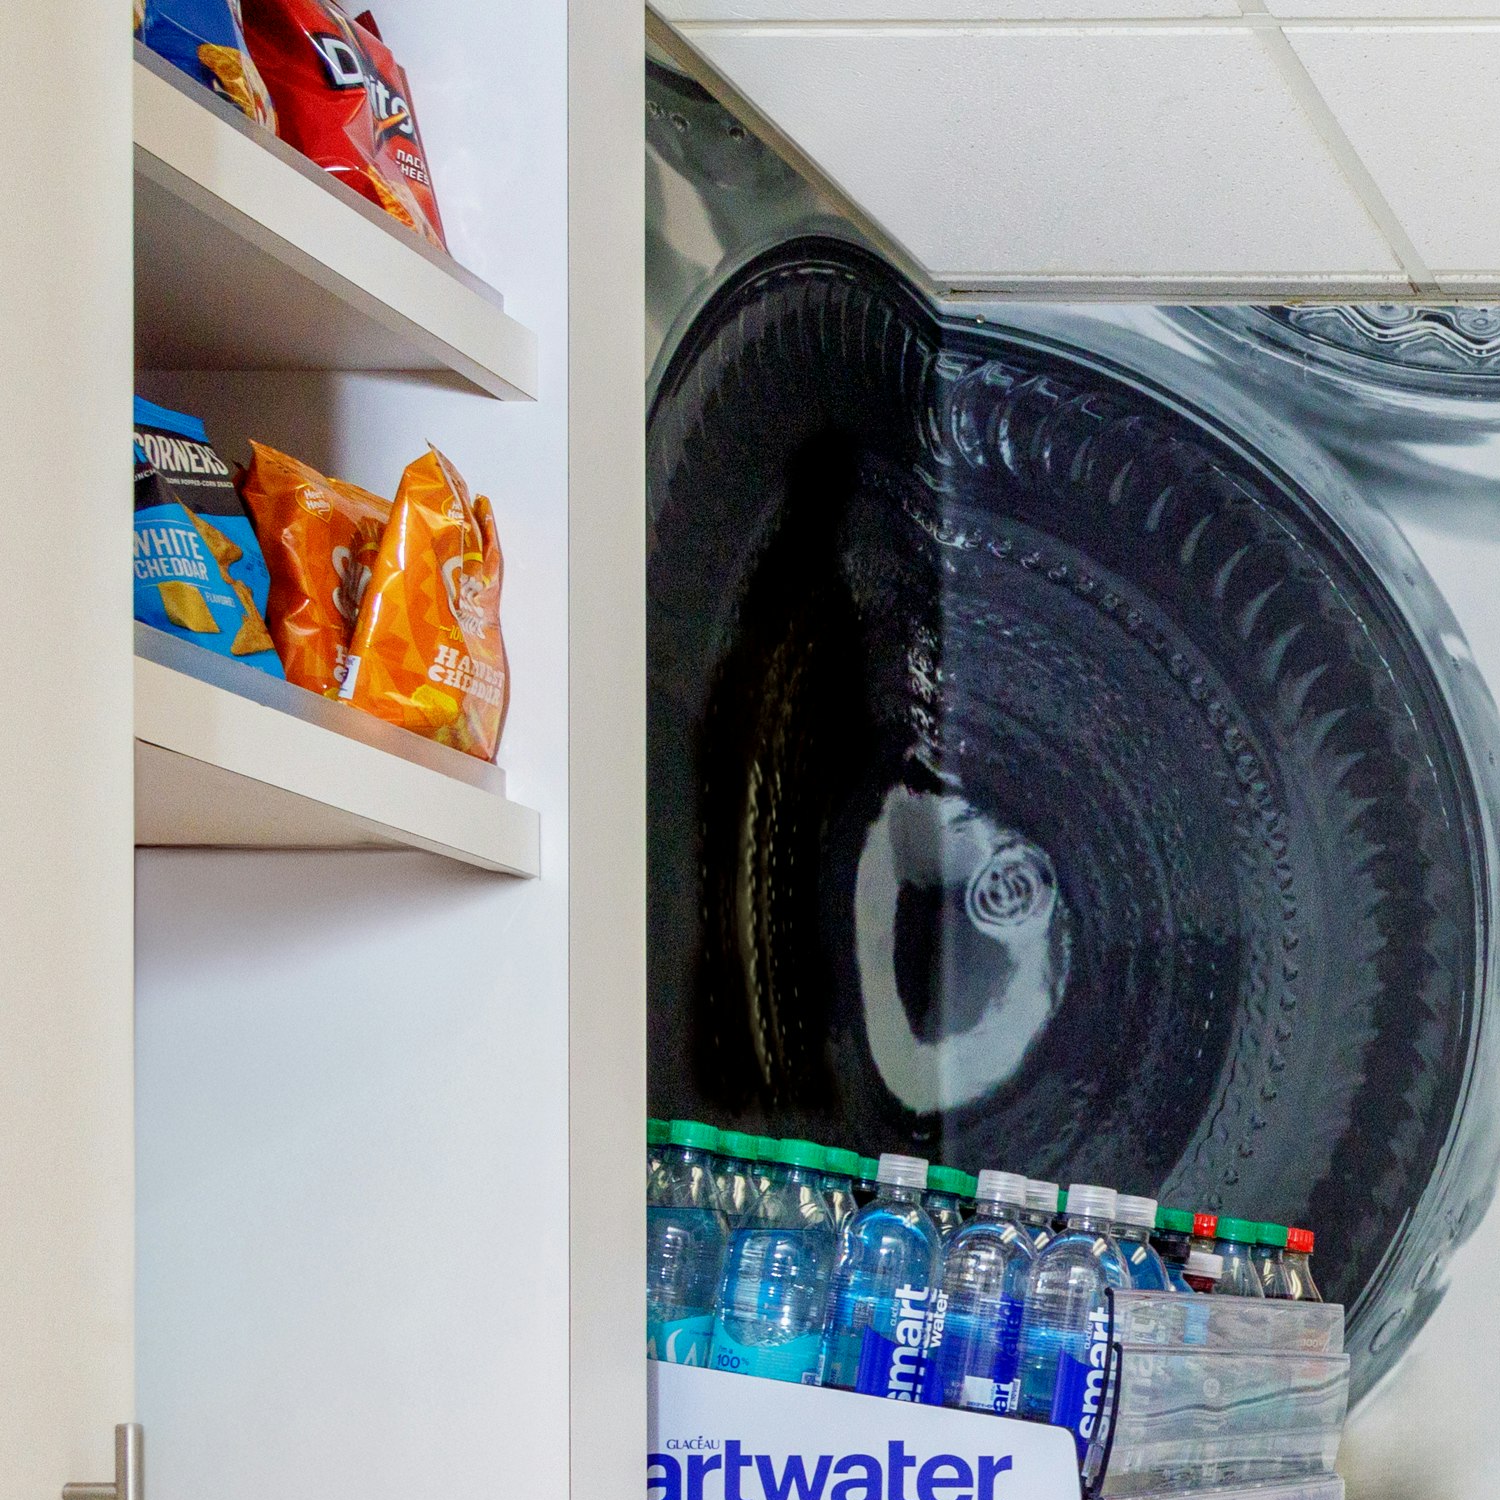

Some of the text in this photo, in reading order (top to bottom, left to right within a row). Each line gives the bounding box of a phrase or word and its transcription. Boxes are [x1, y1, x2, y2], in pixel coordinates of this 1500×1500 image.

[135, 560, 208, 581] CHEDDAR
[930, 1289, 949, 1348] water
[666, 1435, 720, 1450] GLACÉAU
